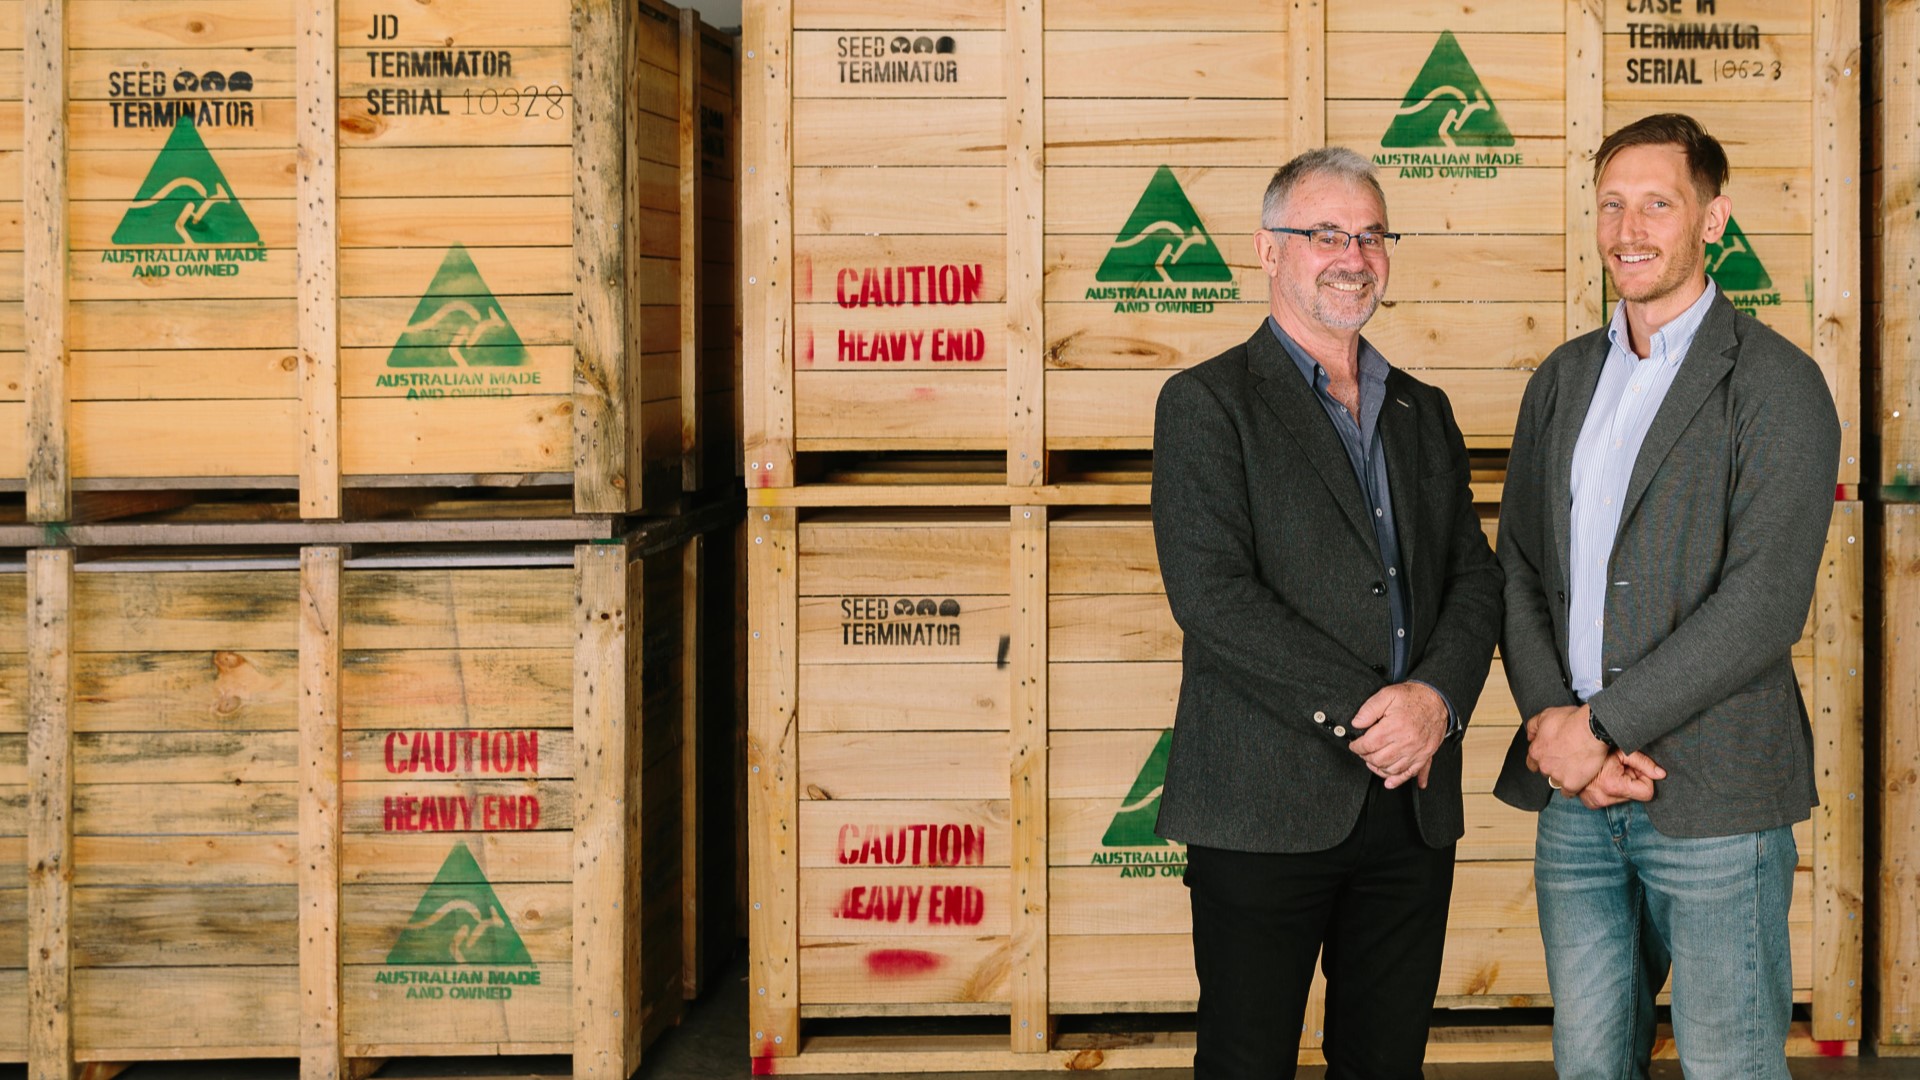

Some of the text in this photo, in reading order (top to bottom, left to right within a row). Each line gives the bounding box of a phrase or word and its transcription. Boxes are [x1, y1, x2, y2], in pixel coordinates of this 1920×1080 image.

[367, 14, 398, 40] JD
[1626, 23, 1760, 50] TERMINATOR
[837, 36, 885, 58] SEED
[366, 51, 512, 77] TERMINATOR
[837, 60, 958, 83] TERMINATOR
[1626, 58, 1782, 84] SERIAL 10623
[108, 71, 167, 97] SEED
[366, 85, 565, 120] SERIAL 10328
[109, 101, 254, 128] TERMINATOR
[1371, 153, 1524, 166] AUSTRALIAN MADE
[1399, 166, 1498, 179] AND OWNED
[101, 248, 268, 263] AUSTRALIAN MADE
[132, 263, 239, 277] AND OWNED
[836, 264, 984, 309] CAUTION
[1085, 287, 1240, 300] AUSTRALIAN MADE
[1113, 301, 1214, 313] AND OWNED
[1733, 293, 1781, 307] MADE
[837, 328, 986, 362] HEAVY END
[376, 371, 541, 387] AUSTRALIAN MADE
[406, 388, 445, 400] AND
[841, 598, 889, 620] SEED
[841, 622, 960, 646] TERMINATOR
[384, 731, 539, 774] CAUTION
[384, 795, 540, 831] HEAVY END
[838, 824, 985, 866] CAUTION
[1120, 866, 1156, 878] AND
[928, 885, 985, 925] END
[375, 970, 541, 985] AUSTRALIAN MADE
[406, 986, 512, 1000] AND OWNED
